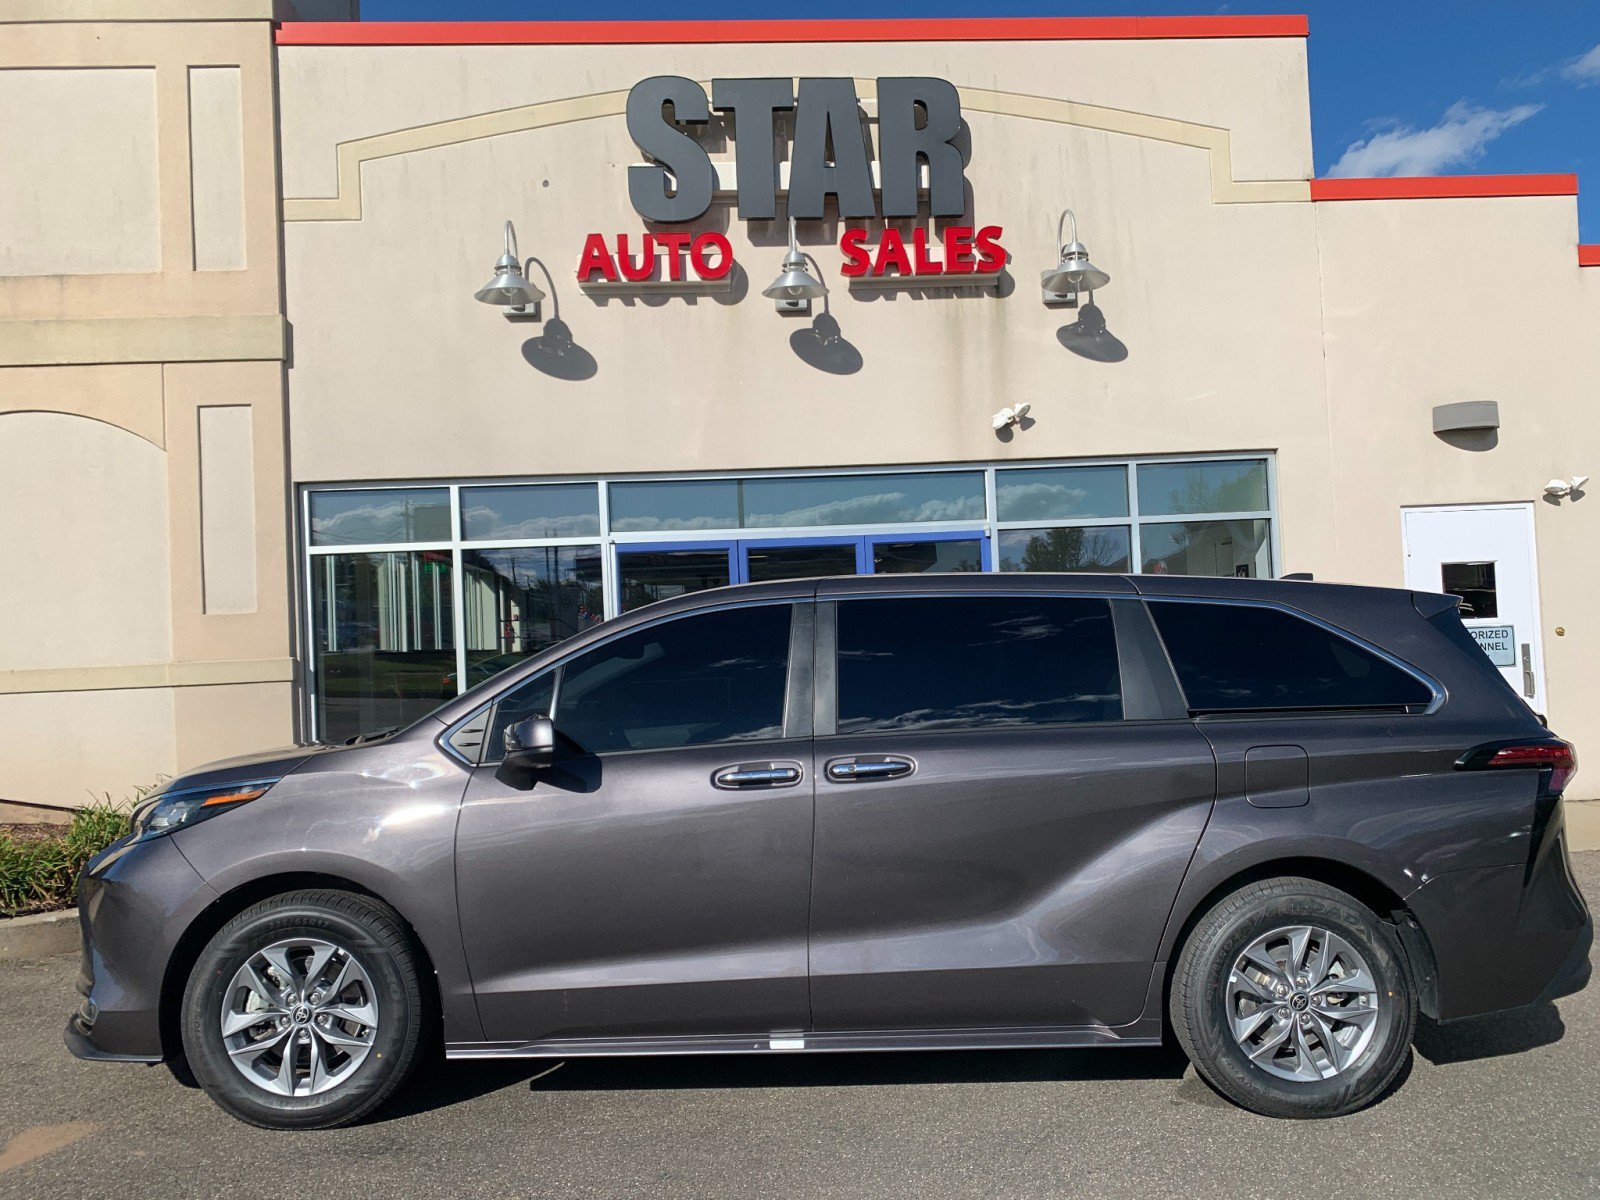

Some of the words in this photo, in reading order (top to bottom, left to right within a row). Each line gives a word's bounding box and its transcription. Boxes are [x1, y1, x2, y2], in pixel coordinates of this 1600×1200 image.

[626, 75, 965, 222] STAR
[577, 231, 733, 282] AUTO
[840, 226, 1008, 277] SALES
